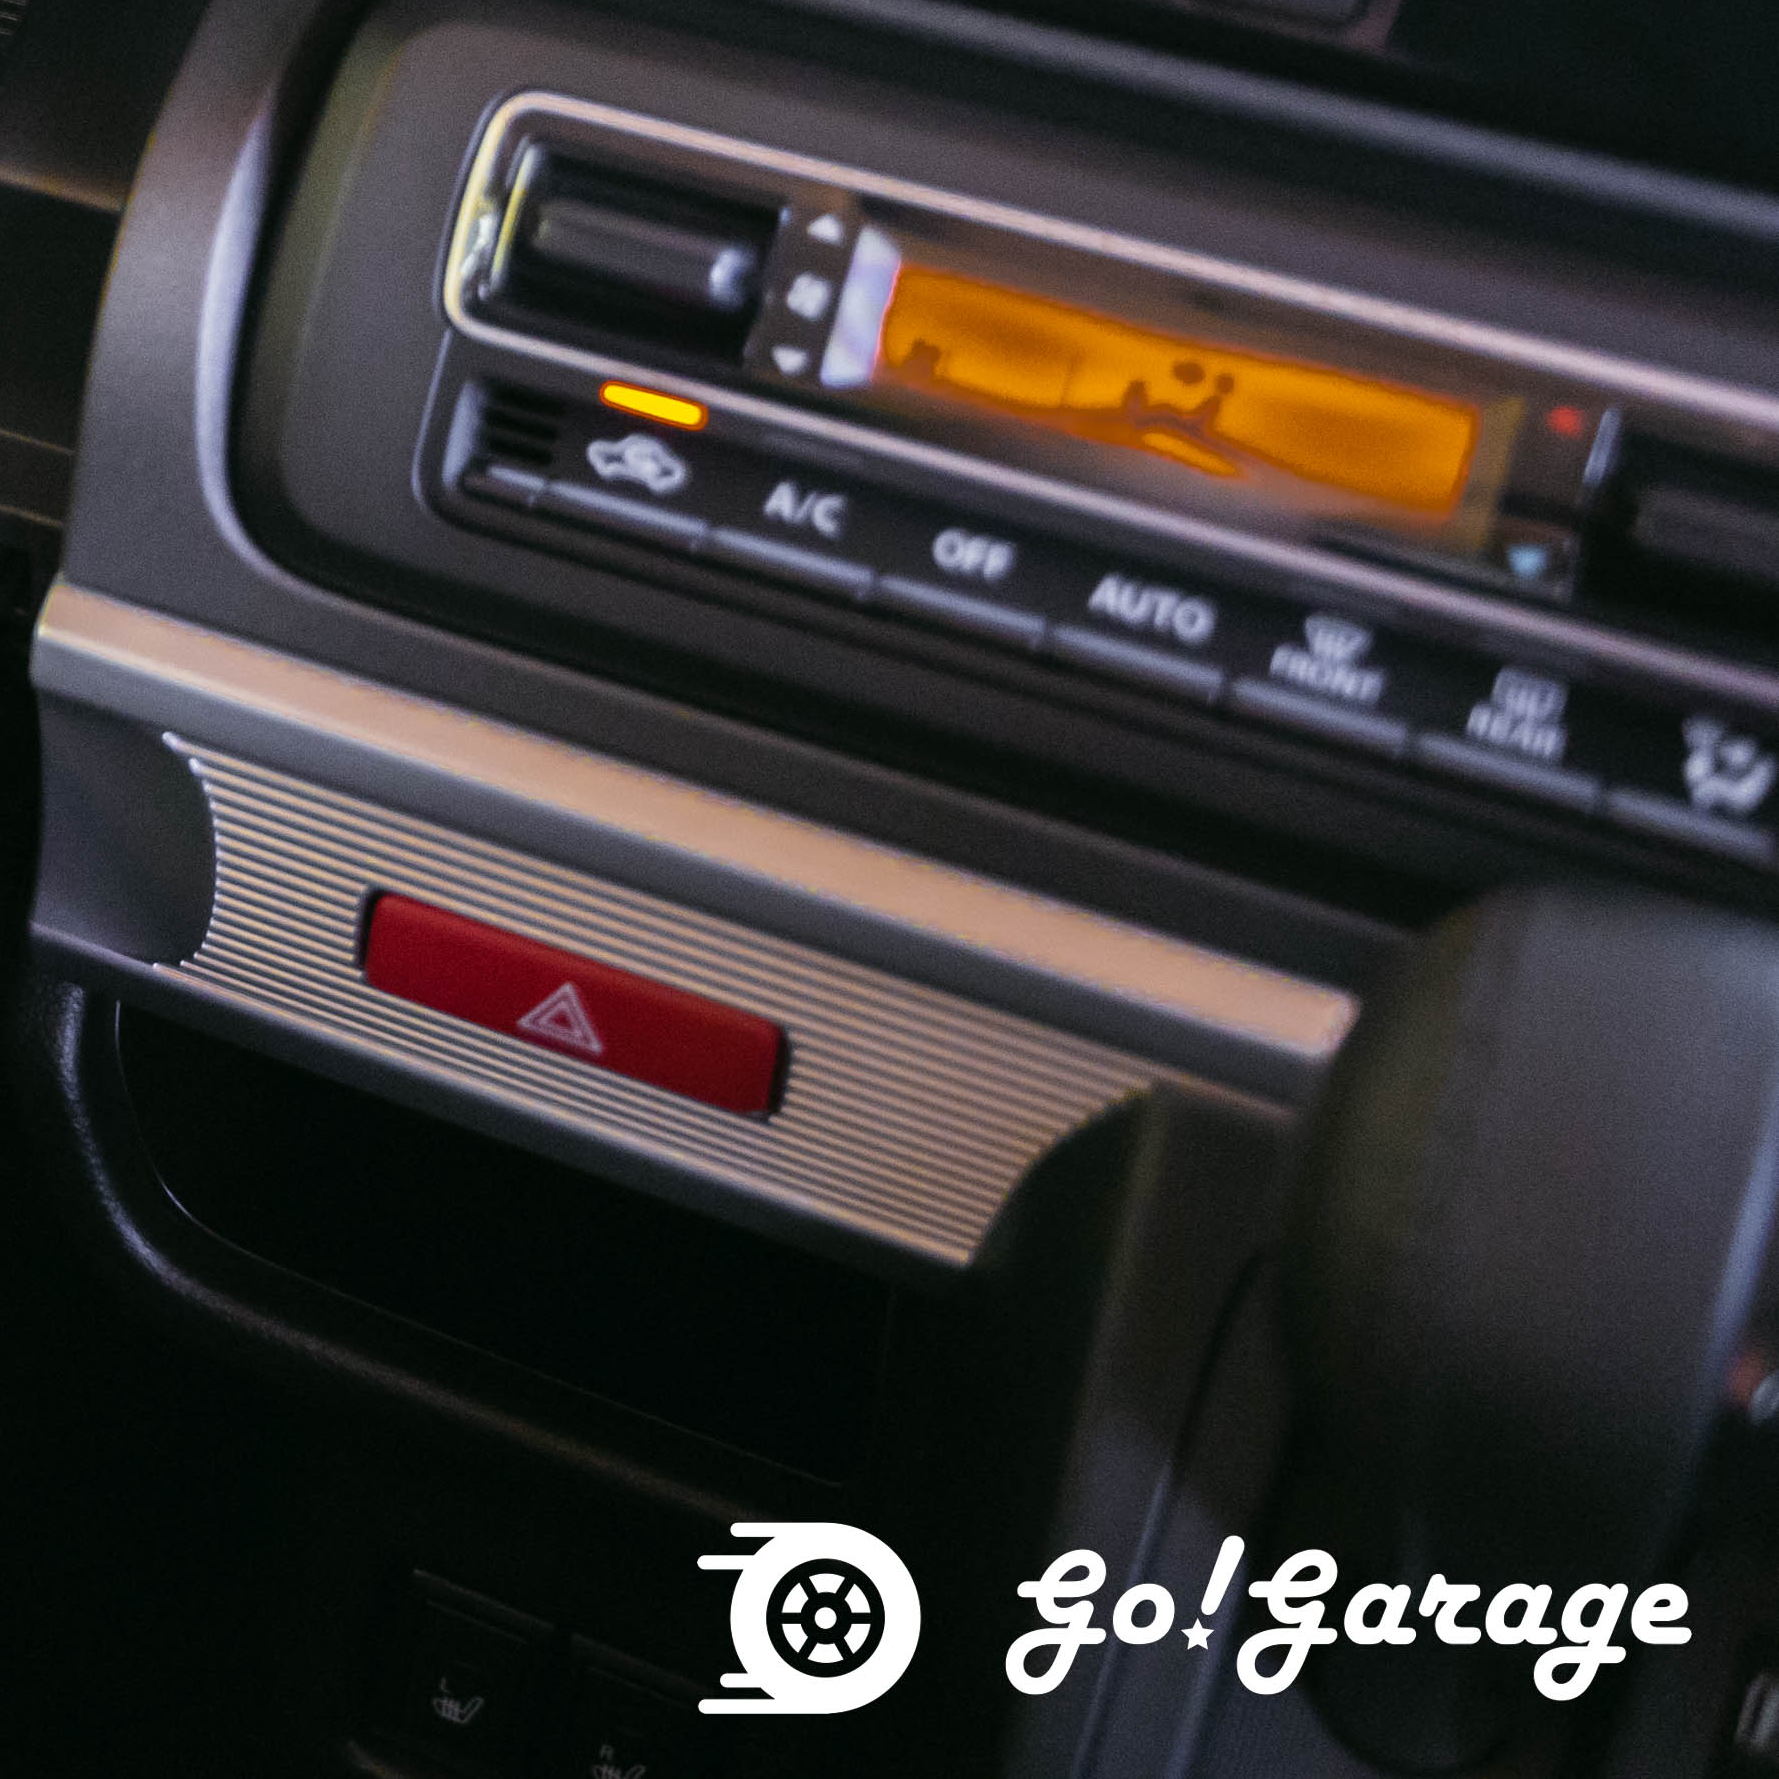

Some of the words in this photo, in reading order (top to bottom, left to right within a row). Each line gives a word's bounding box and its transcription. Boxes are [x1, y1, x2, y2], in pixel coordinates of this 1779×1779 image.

[763, 479, 846, 541] A/C
[931, 526, 1015, 583] OFF
[1088, 571, 1217, 646] AUTO
[1269, 643, 1385, 705] FRONT
[1467, 702, 1569, 763] REAR
